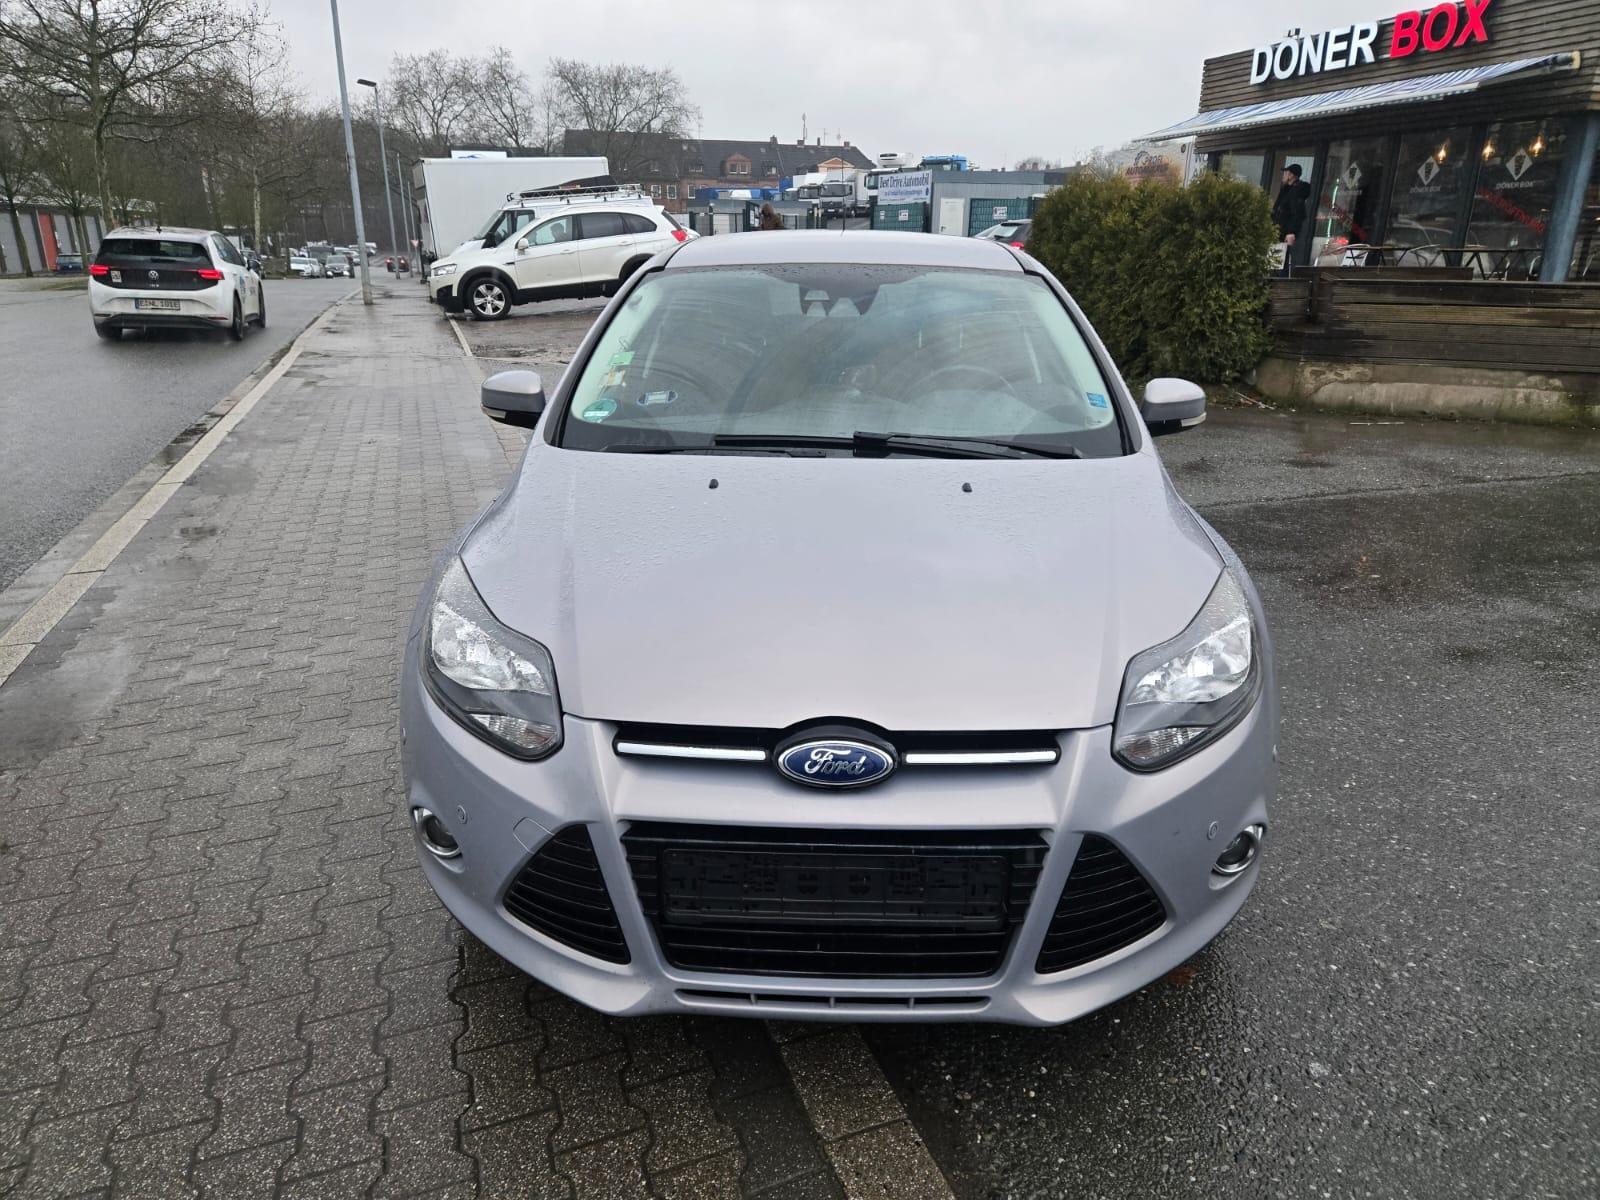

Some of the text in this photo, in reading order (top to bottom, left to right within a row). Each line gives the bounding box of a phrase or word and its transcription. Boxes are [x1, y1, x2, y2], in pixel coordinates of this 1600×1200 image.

[1249, 0, 1492, 85] DÖNER BOX
[804, 748, 867, 775] Ford
